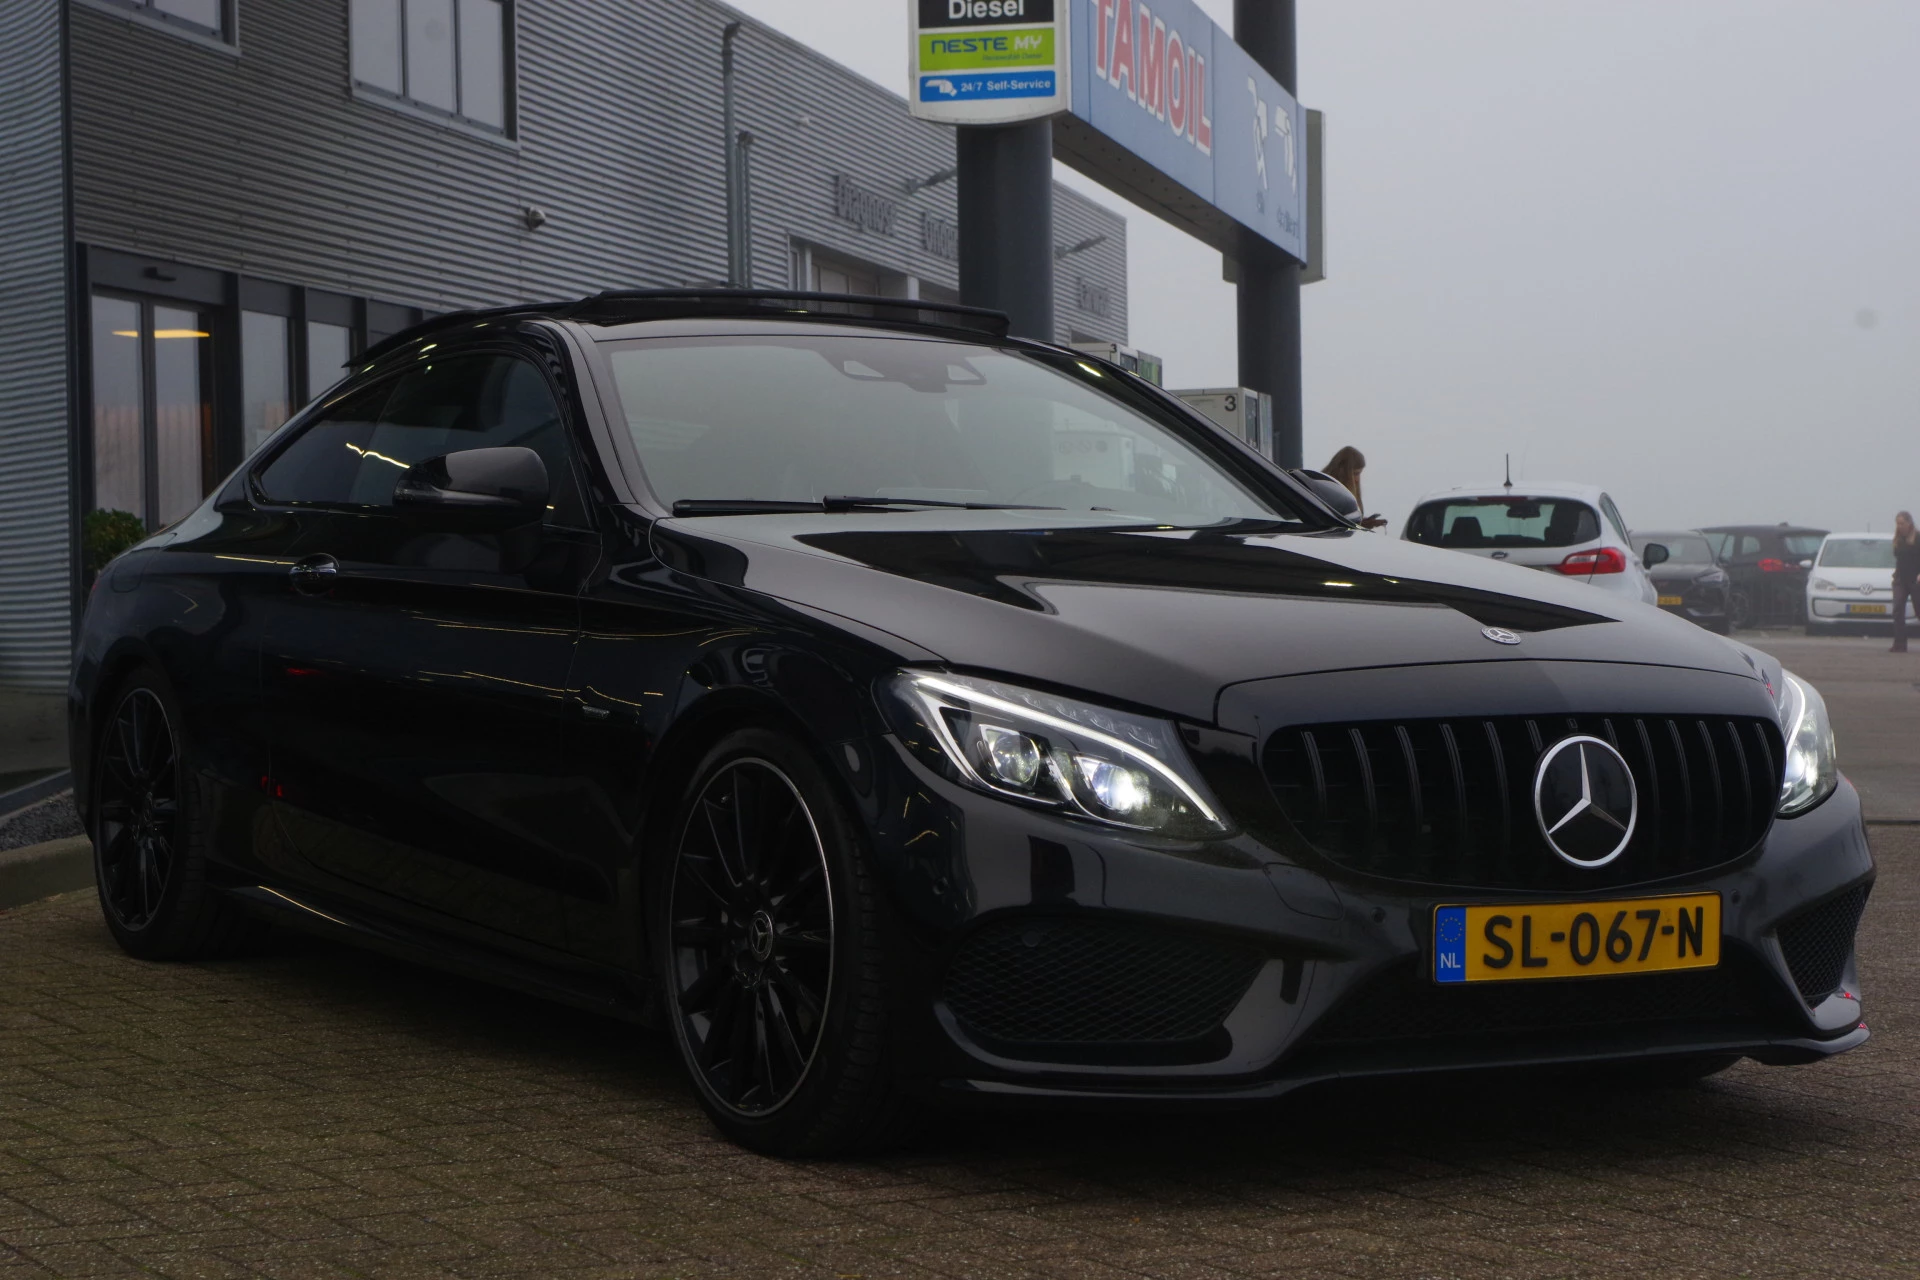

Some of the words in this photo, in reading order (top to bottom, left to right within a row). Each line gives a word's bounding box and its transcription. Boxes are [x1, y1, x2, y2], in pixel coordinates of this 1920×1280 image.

[949, 0, 1024, 19] Diesel
[1013, 34, 1042, 51] MY
[961, 82, 982, 92] 24/7
[987, 79, 1051, 91] Self-Service
[1091, 0, 1212, 157] TAMOIL
[1224, 395, 1237, 412] 3
[1483, 906, 1704, 970] SL-067-N
[1440, 953, 1461, 969] NL
